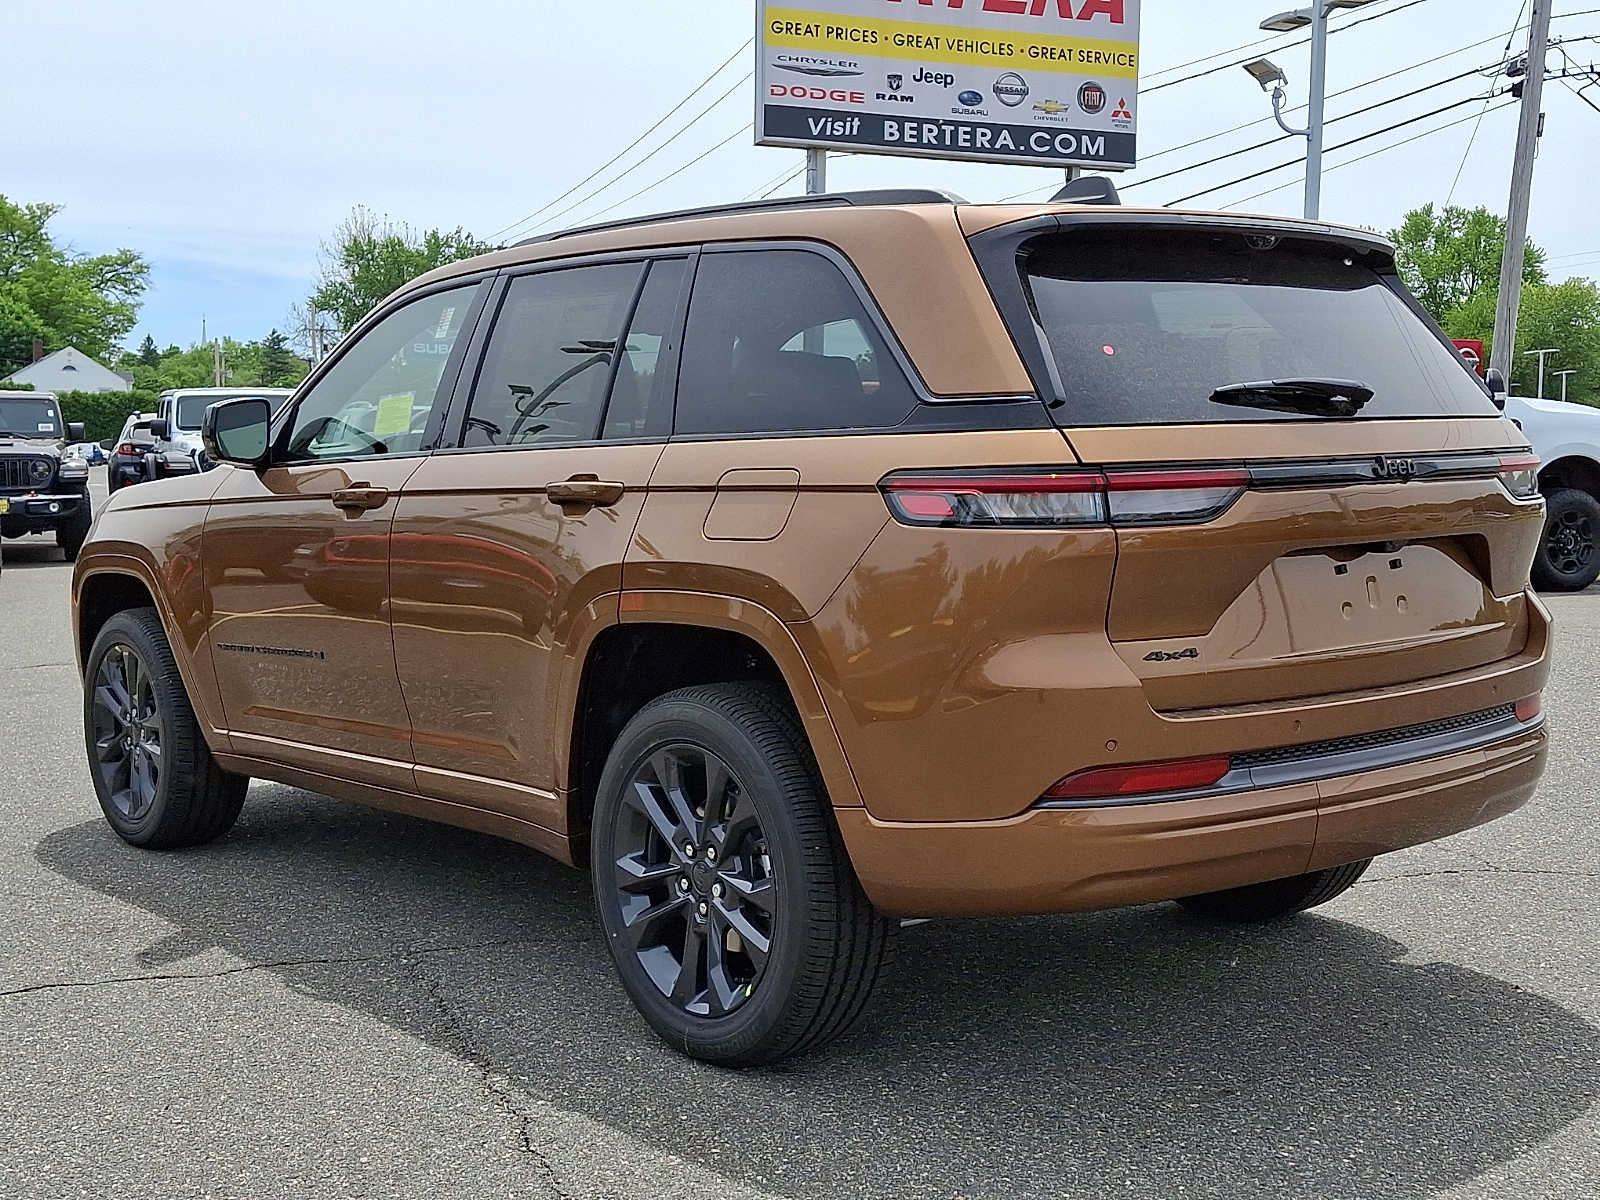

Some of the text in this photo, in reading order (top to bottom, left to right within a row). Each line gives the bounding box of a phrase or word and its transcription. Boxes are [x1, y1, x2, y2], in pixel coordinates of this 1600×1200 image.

[771, 20, 1135, 67] GREAT PRICES GREAT VEHICLES GREAT SERVICE
[777, 55, 858, 68] CHRYSLER
[912, 67, 955, 88] Jeep
[770, 84, 865, 104] DODGE
[996, 85, 1026, 95] NISSAN
[875, 93, 914, 103] RAM
[1084, 91, 1101, 106] FIAT
[951, 107, 989, 116] SUBARU
[1033, 115, 1069, 123] CHEVROLET
[807, 117, 1105, 156] Visit BERTERA.COM
[1142, 647, 1199, 661] 4x4
